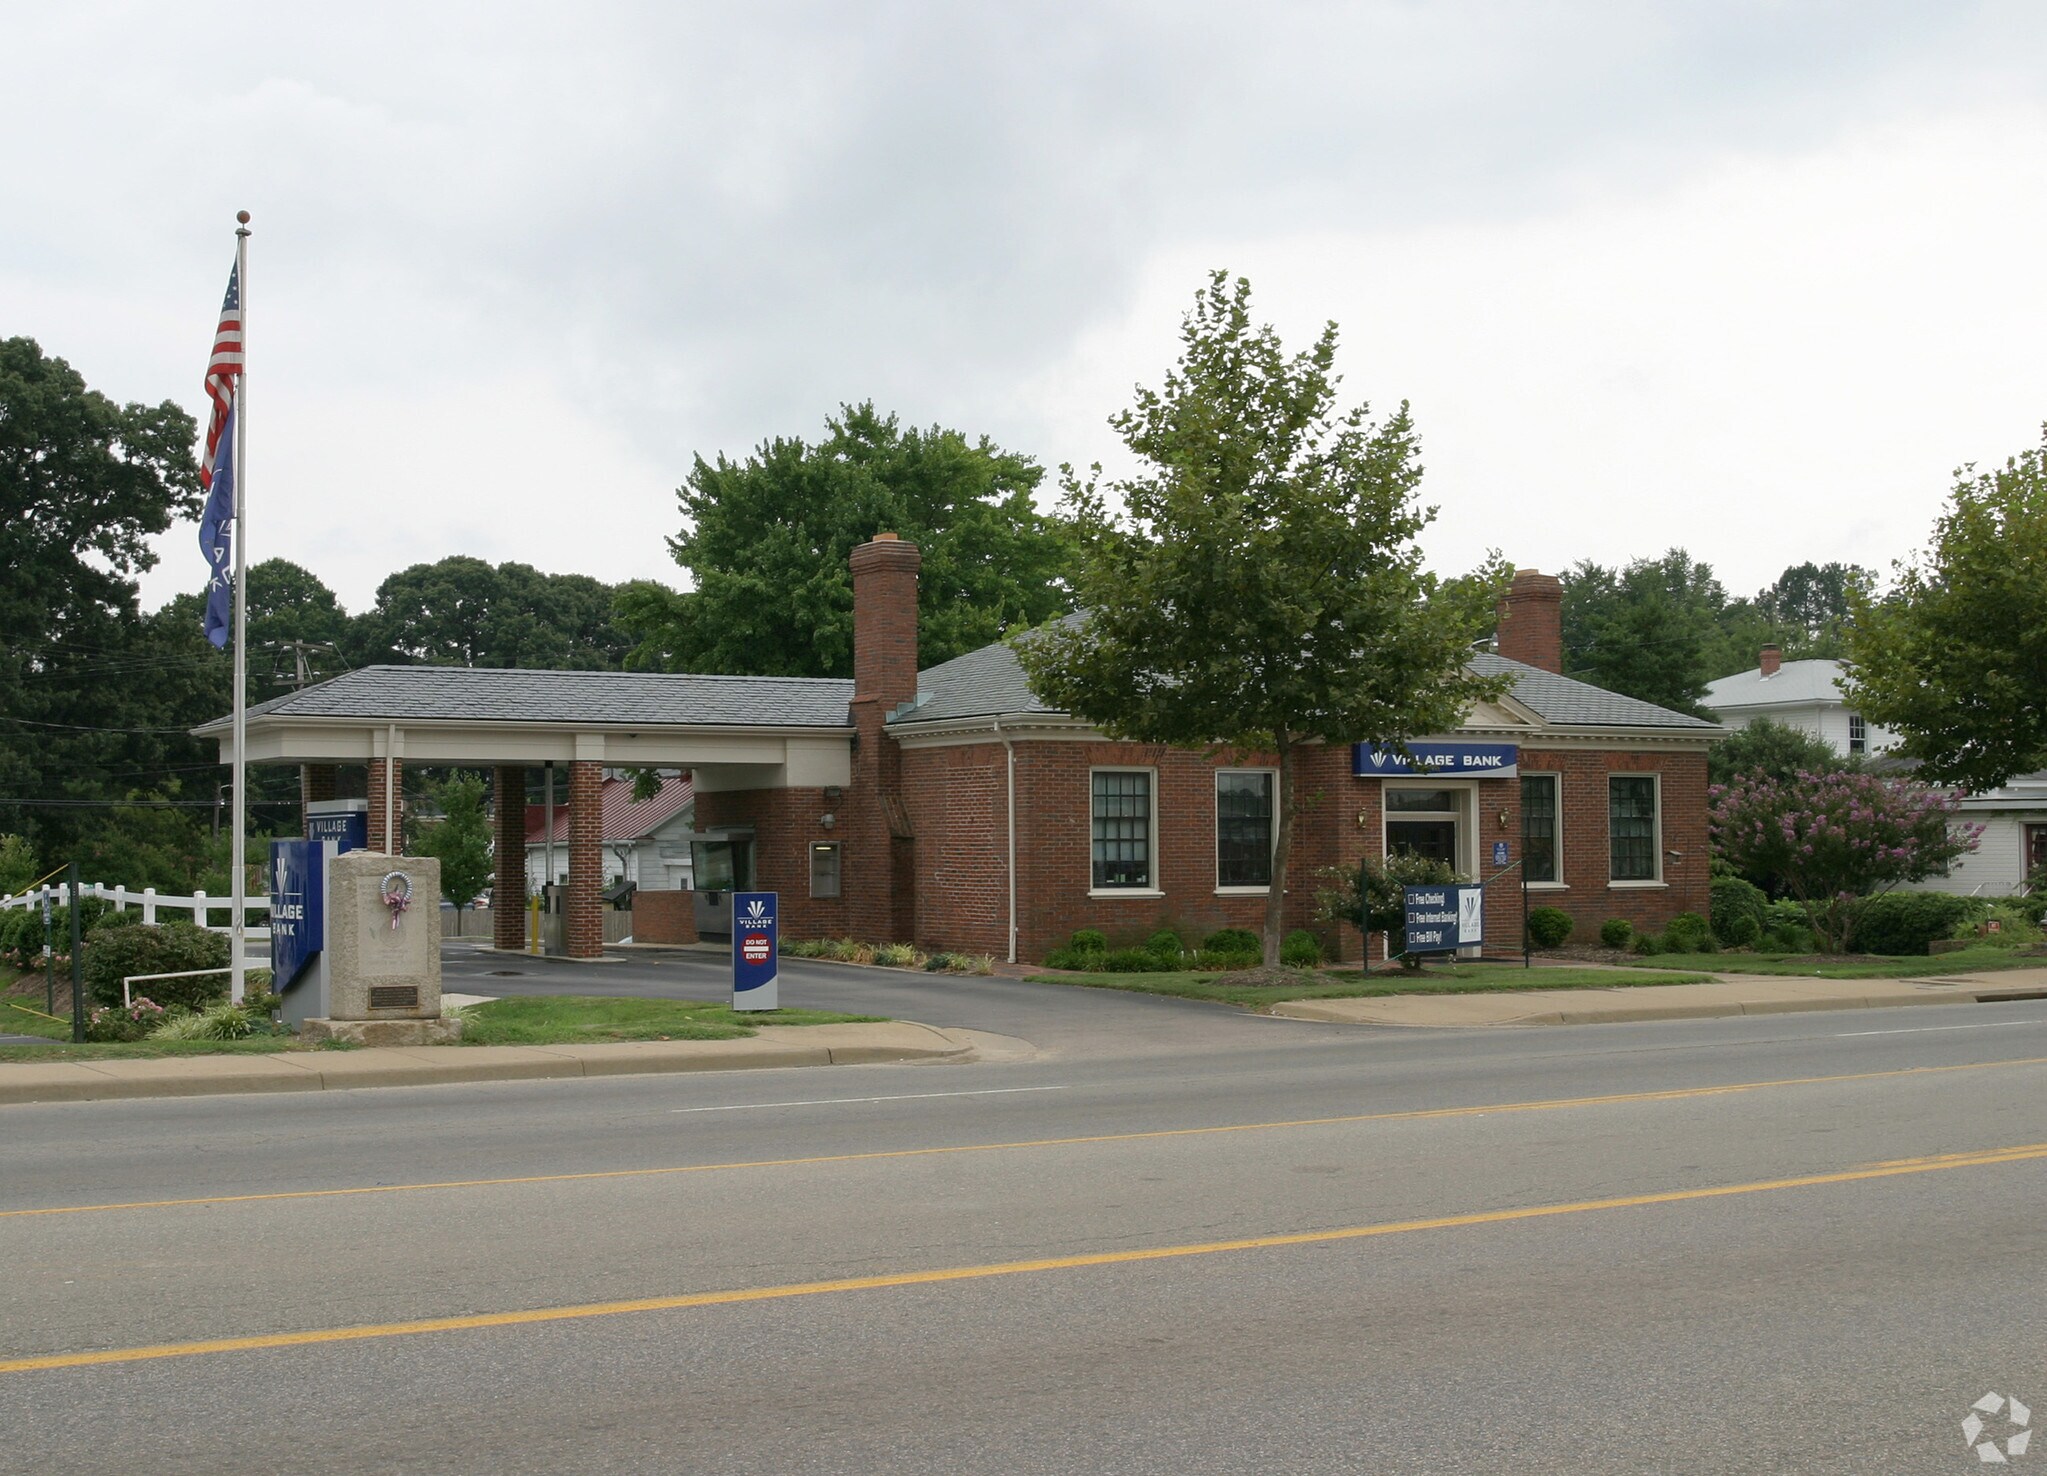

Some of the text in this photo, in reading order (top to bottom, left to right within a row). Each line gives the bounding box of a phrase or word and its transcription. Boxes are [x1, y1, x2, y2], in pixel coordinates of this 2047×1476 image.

[1463, 755, 1502, 766] BANK
[316, 820, 347, 832] VILLAGE
[1415, 893, 1425, 904] Free
[1416, 912, 1426, 923] Free
[1416, 931, 1425, 943] Free
